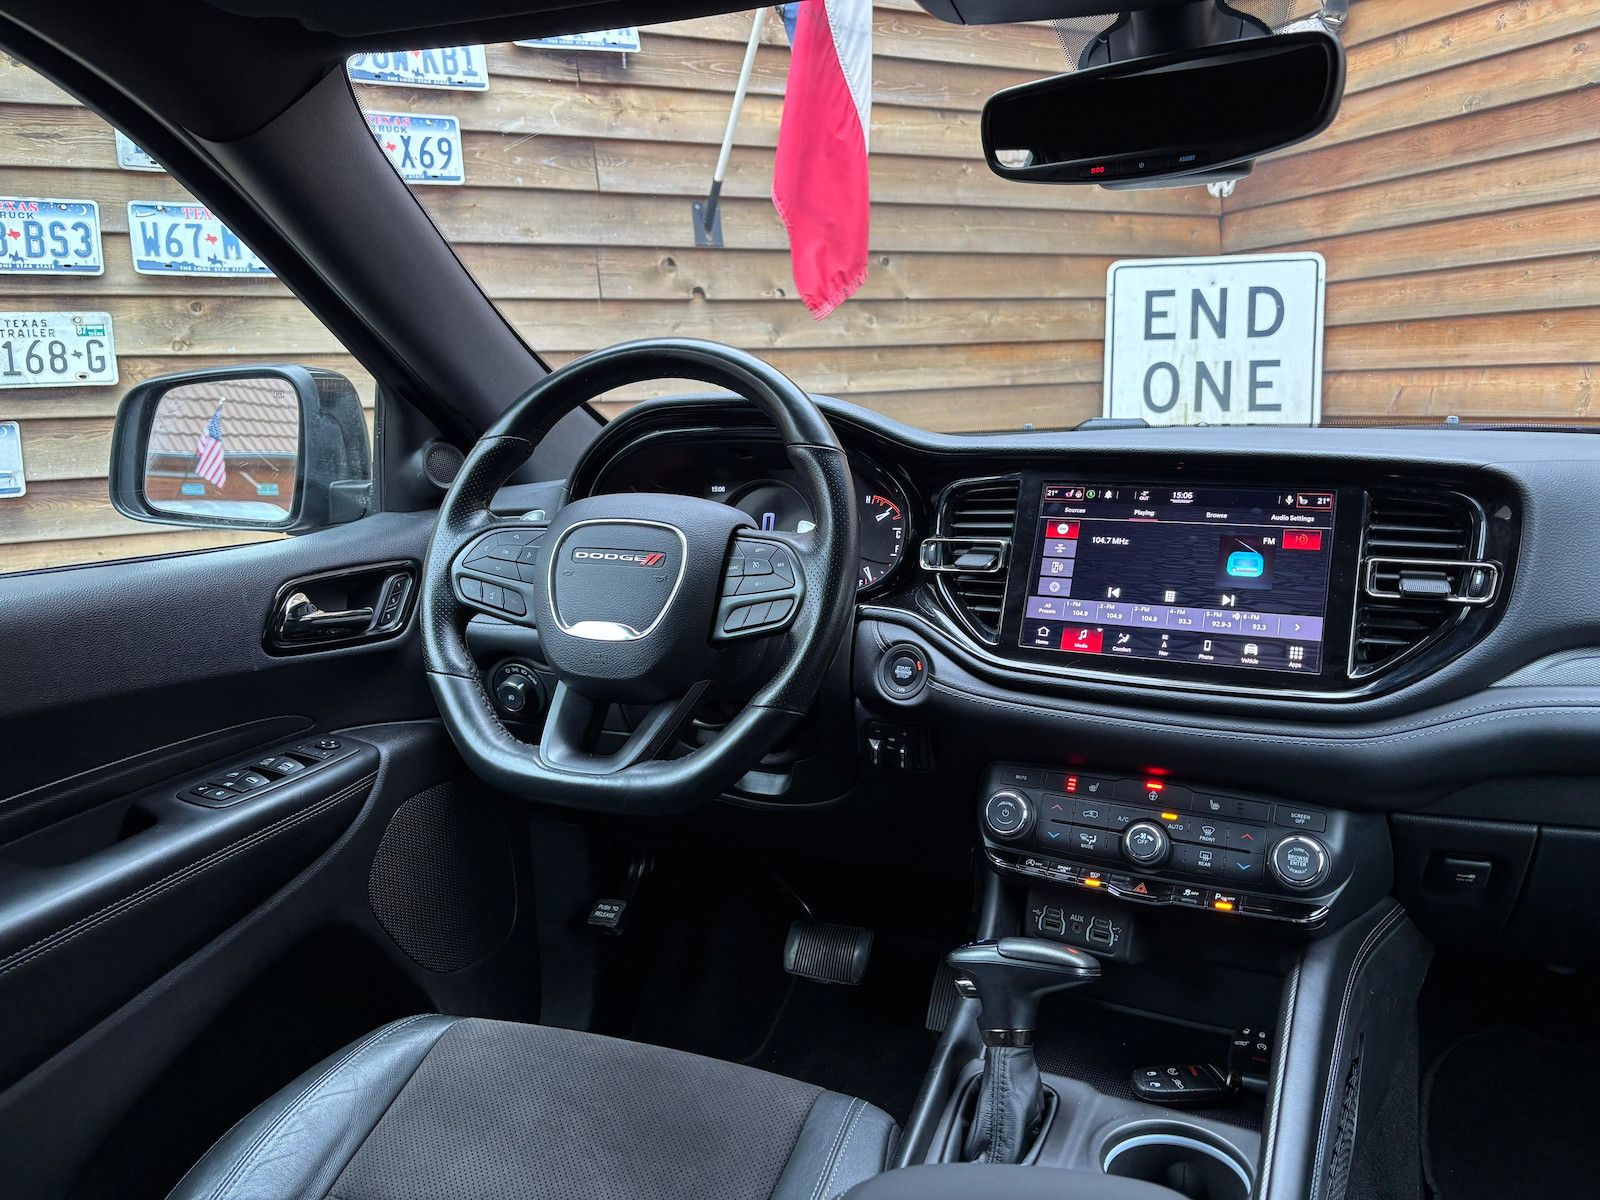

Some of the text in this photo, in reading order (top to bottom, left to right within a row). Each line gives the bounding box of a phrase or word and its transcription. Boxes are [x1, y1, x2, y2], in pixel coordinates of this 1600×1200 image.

[400, 135, 452, 170] X69
[182, 207, 214, 220] TEX
[23, 220, 93, 258] BS3
[140, 221, 256, 260] W67 M
[1144, 286, 1285, 341] END
[4, 319, 47, 328] TEXAS
[0, 328, 56, 338] TRAILER
[2, 339, 106, 376] 168 G
[1143, 360, 1282, 414] ONE
[1172, 491, 1193, 499] 15:06
[1134, 509, 1155, 517] Playing
[1092, 536, 1111, 544] 104.7
[1263, 537, 1276, 545] FM
[575, 551, 648, 563] DODGE
[1241, 657, 1259, 665] Vehicle
[1288, 661, 1302, 669] Apps
[1117, 815, 1129, 823] A/C
[1290, 812, 1311, 820] SCREEN
[1167, 823, 1184, 831] AUTO
[1199, 835, 1216, 843] FRONT
[1287, 854, 1309, 862] BROWSE
[1069, 914, 1085, 922] AUX
